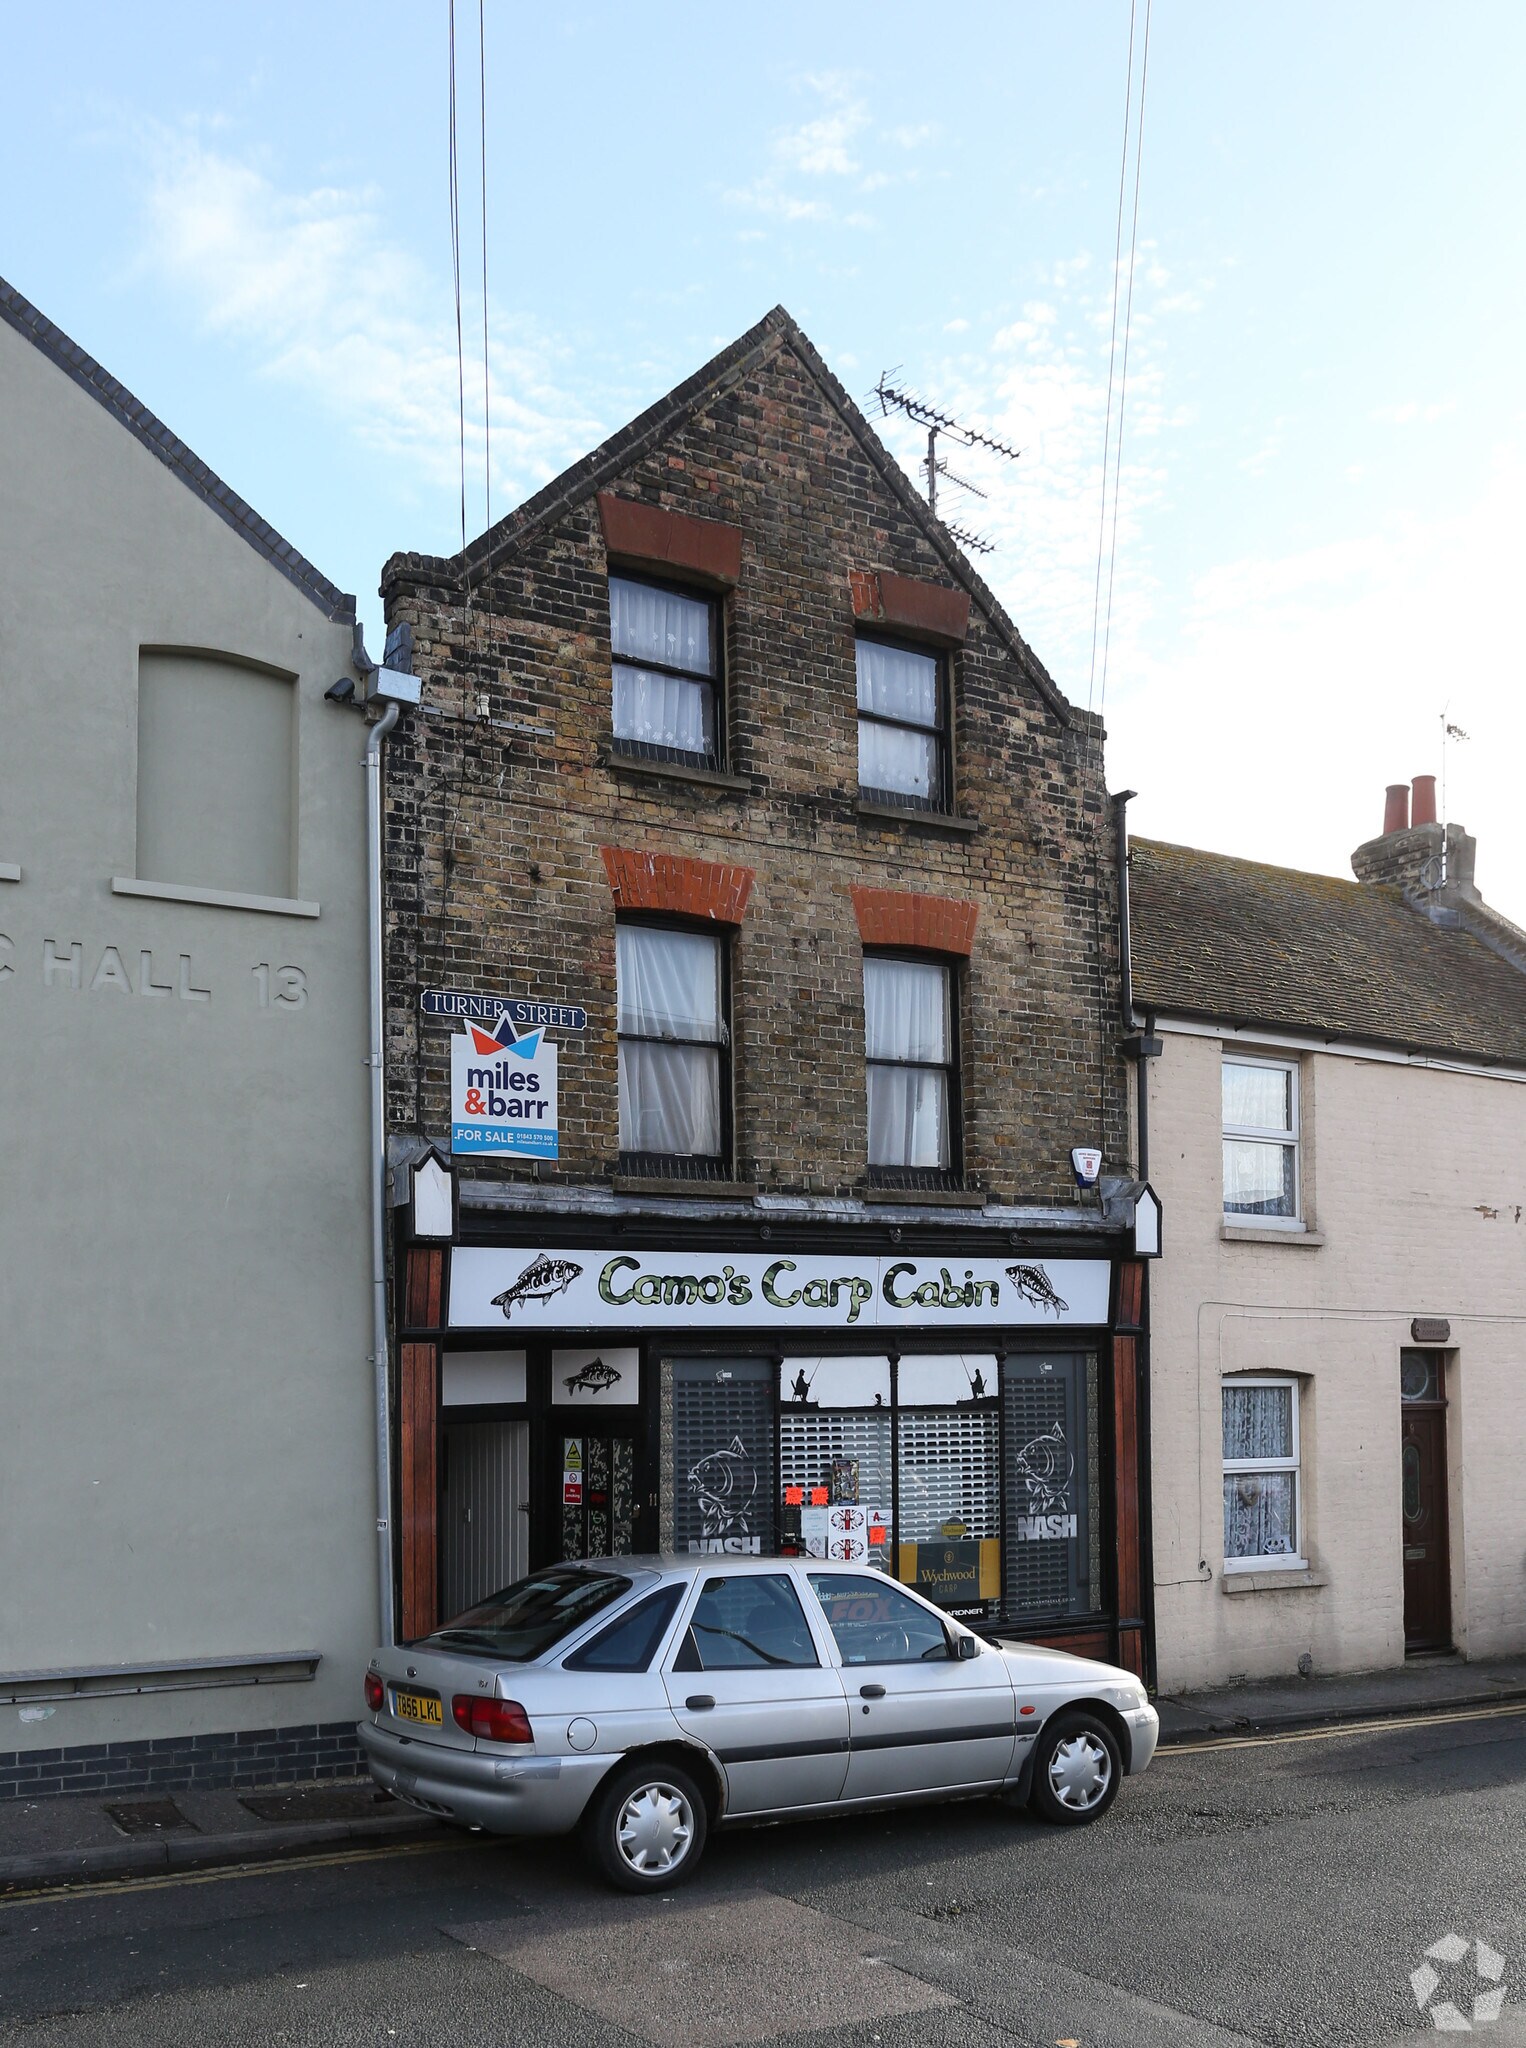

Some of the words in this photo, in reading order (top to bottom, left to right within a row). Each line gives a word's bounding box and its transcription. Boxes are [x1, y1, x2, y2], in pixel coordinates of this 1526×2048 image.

[44, 939, 211, 1001] HALL
[252, 963, 308, 1010] 13
[432, 994, 504, 1018] TURNER
[516, 1003, 578, 1027] STREET
[467, 1061, 540, 1093] miles
[457, 1129, 482, 1141] FOR
[485, 1131, 514, 1143] SALE
[516, 1132, 532, 1140] 01843
[544, 1134, 554, 1142] 500
[598, 1256, 752, 1305] Camo's
[761, 1260, 873, 1323] Carp
[883, 1263, 999, 1308] Cabin
[1017, 1514, 1078, 1541] NASH
[921, 1566, 976, 1586] Wychwood
[939, 1583, 958, 1594] CARP
[831, 1598, 892, 1622] FOX
[946, 1608, 984, 1617] ARDNER
[397, 1694, 418, 1718] T856
[420, 1699, 442, 1722] LKL
